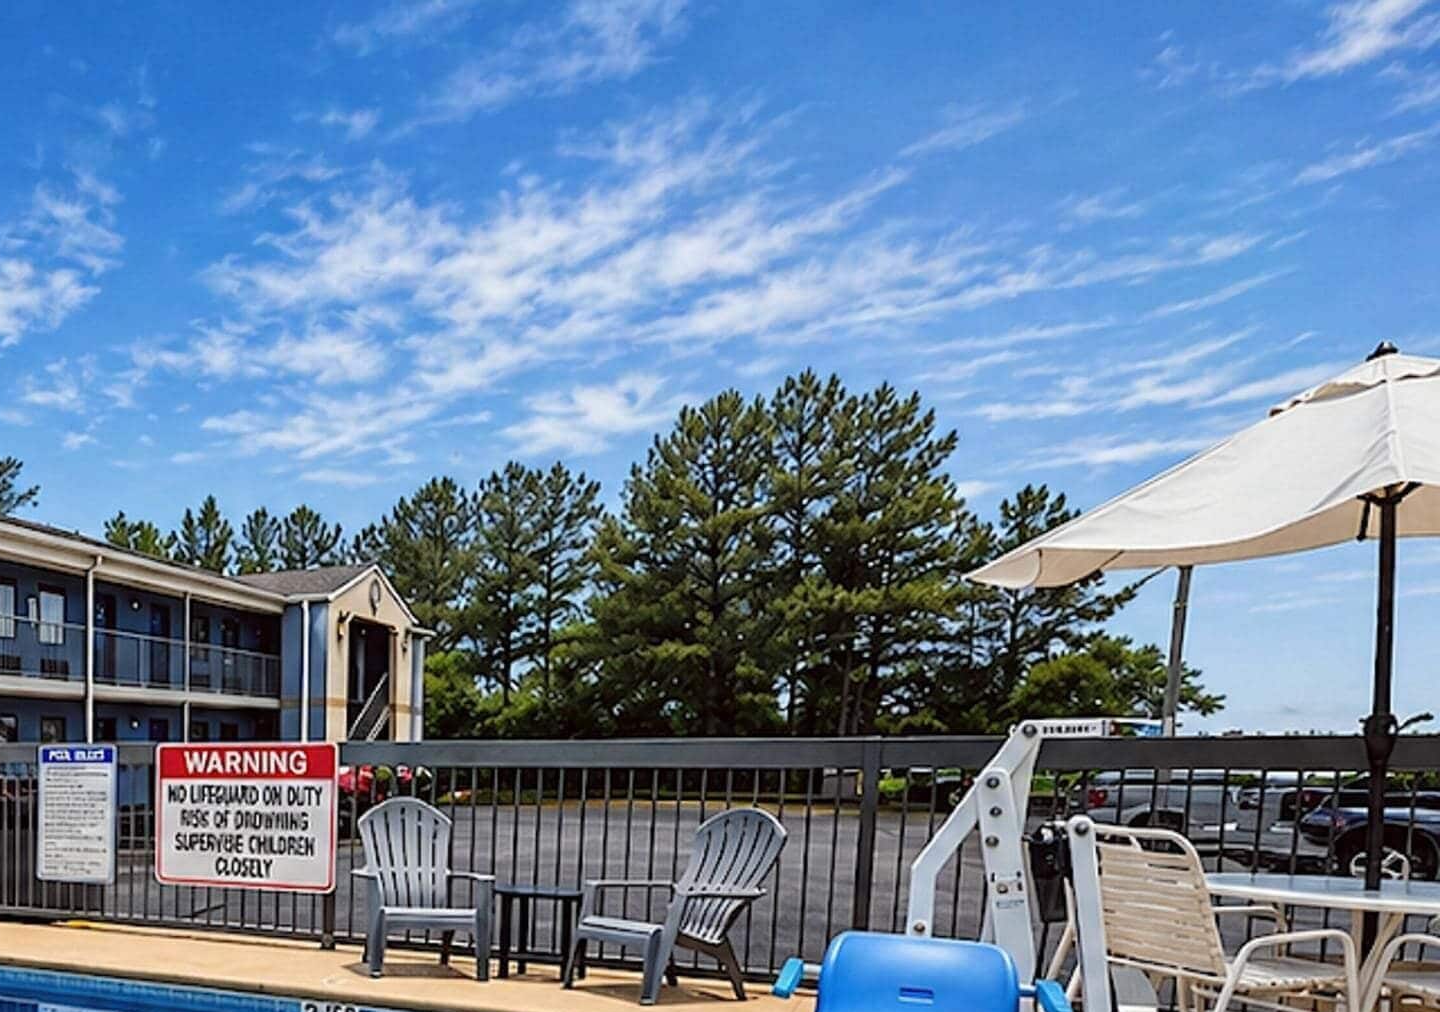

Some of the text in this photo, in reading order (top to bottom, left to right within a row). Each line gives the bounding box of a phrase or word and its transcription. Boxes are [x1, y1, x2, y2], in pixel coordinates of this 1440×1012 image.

[184, 750, 308, 775] WARNING
[168, 784, 323, 807] NO LIFEGUARD ON DUTY
[180, 809, 309, 831] RISK OF DROWNING
[248, 834, 316, 857] CHILDREN
[215, 856, 273, 879] CLOSELY
